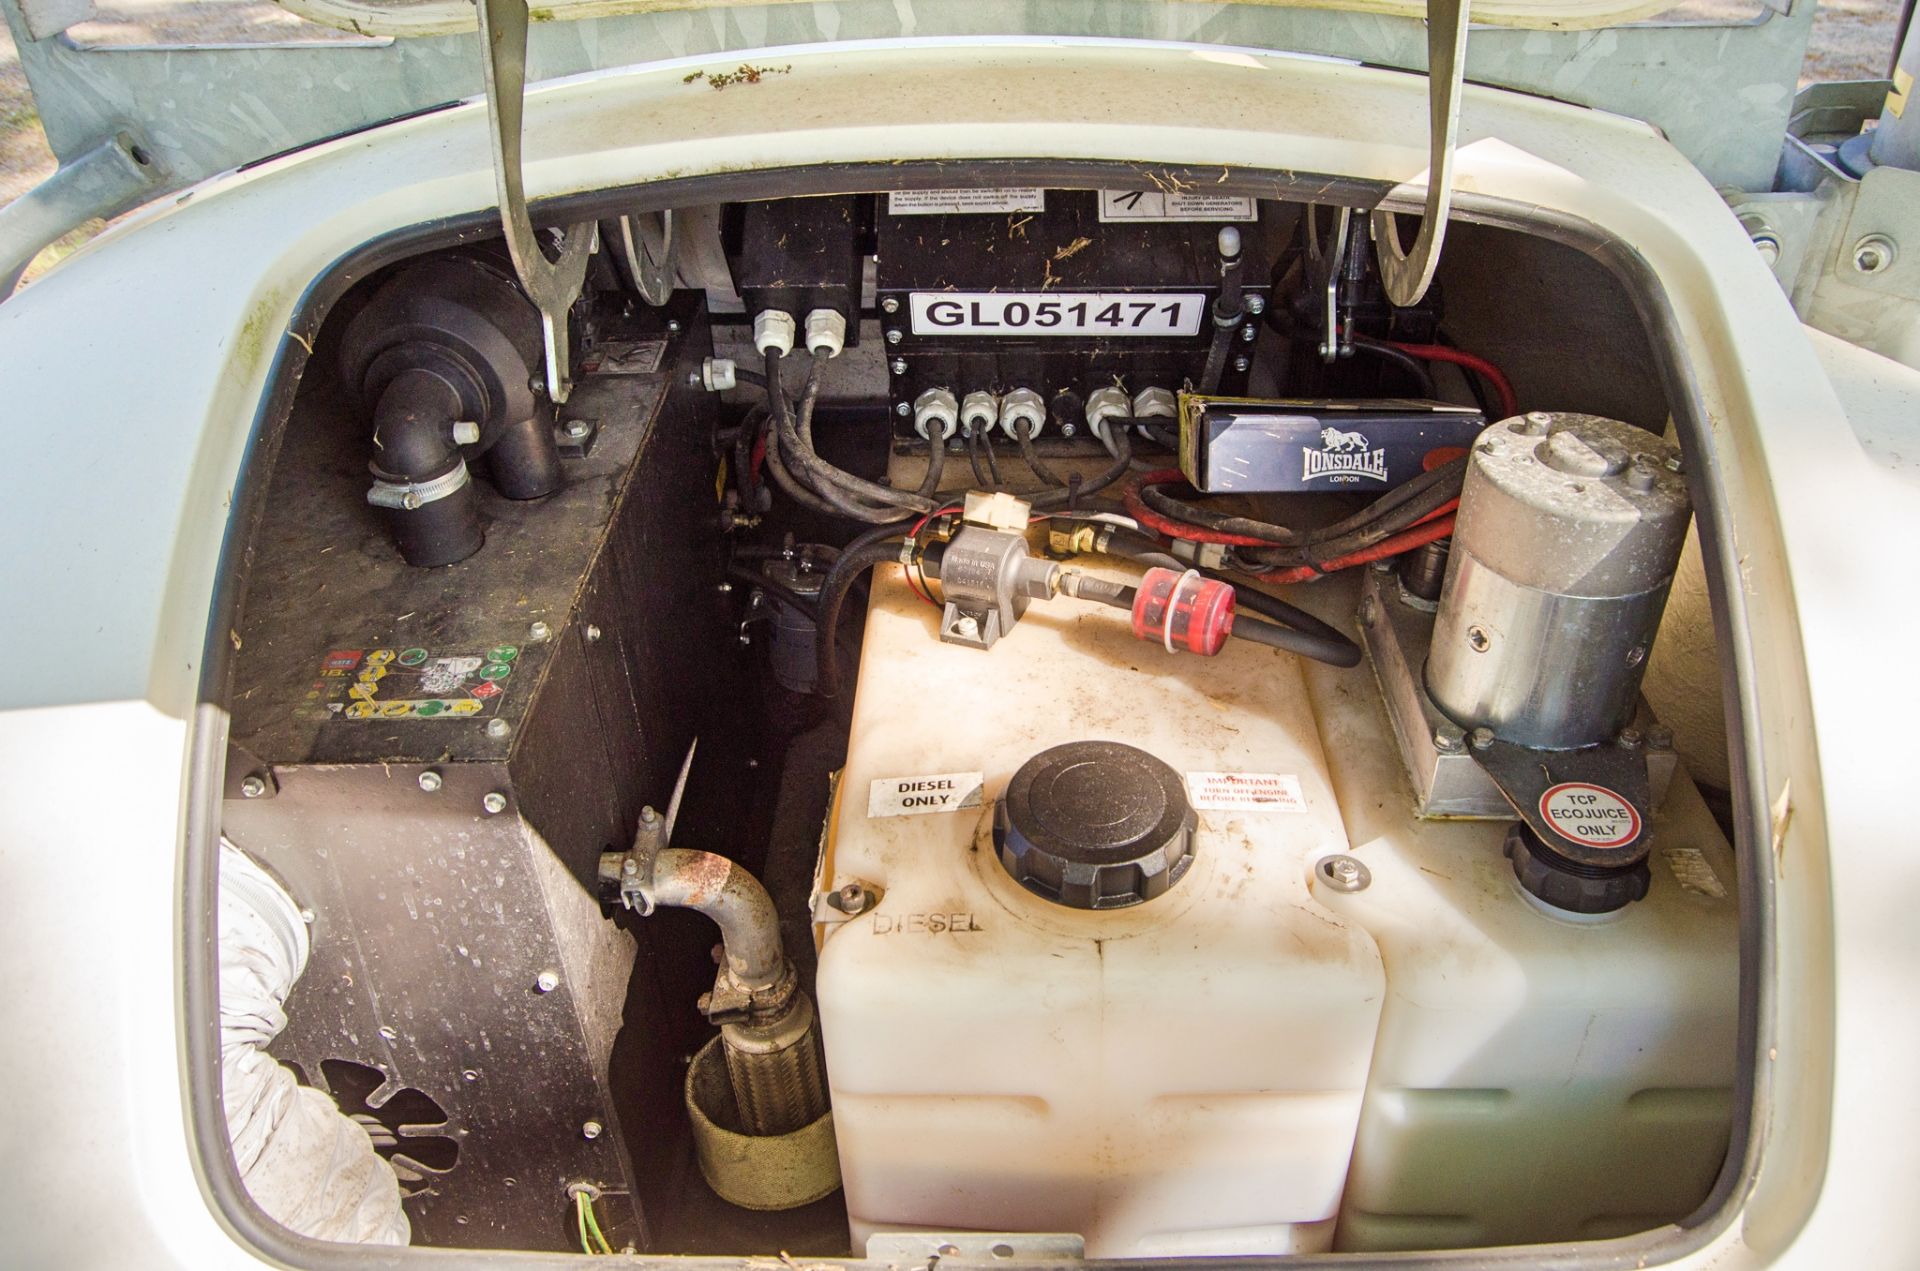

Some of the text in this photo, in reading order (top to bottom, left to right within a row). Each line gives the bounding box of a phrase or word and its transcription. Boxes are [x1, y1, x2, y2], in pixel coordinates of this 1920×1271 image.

[925, 301, 1182, 327] GL051471
[1302, 446, 1387, 482] LONSDALE
[980, 561, 995, 571] USA
[898, 780, 955, 793] DIESEL
[1233, 787, 1250, 795] OFF
[902, 794, 950, 808] ONLY
[1566, 795, 1597, 805] TCP
[1551, 808, 1629, 819] ECOJUICE
[1576, 825, 1616, 835] ONLY
[873, 912, 984, 935] DIESEL
